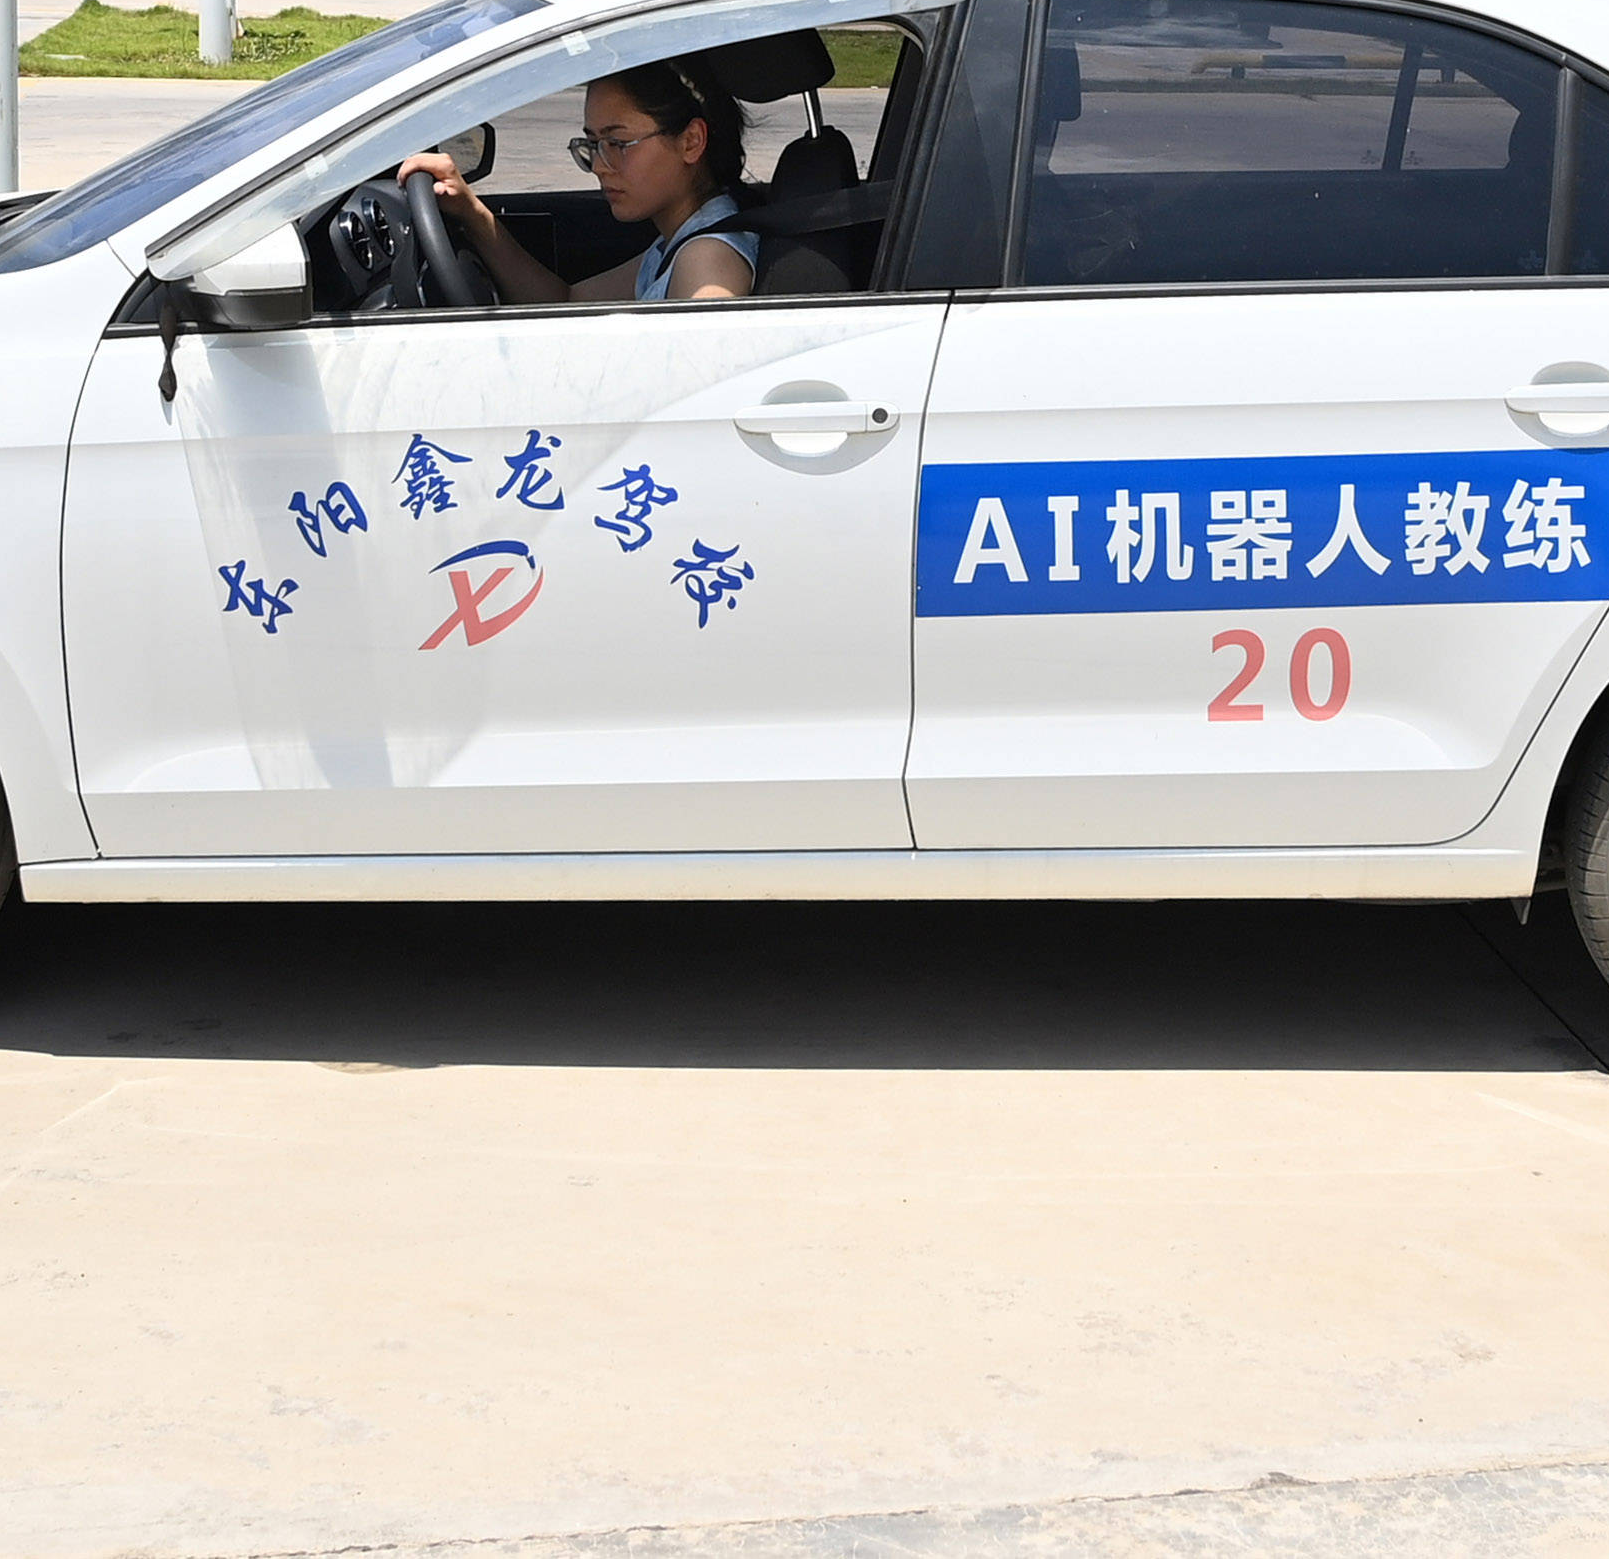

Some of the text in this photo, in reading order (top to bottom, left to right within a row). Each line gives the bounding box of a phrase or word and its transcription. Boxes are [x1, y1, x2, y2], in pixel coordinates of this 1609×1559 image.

[219, 429, 756, 634] 东阳鑫龙驾校
[953, 478, 1591, 584] AI机器人教练
[1207, 627, 1352, 722] 20
